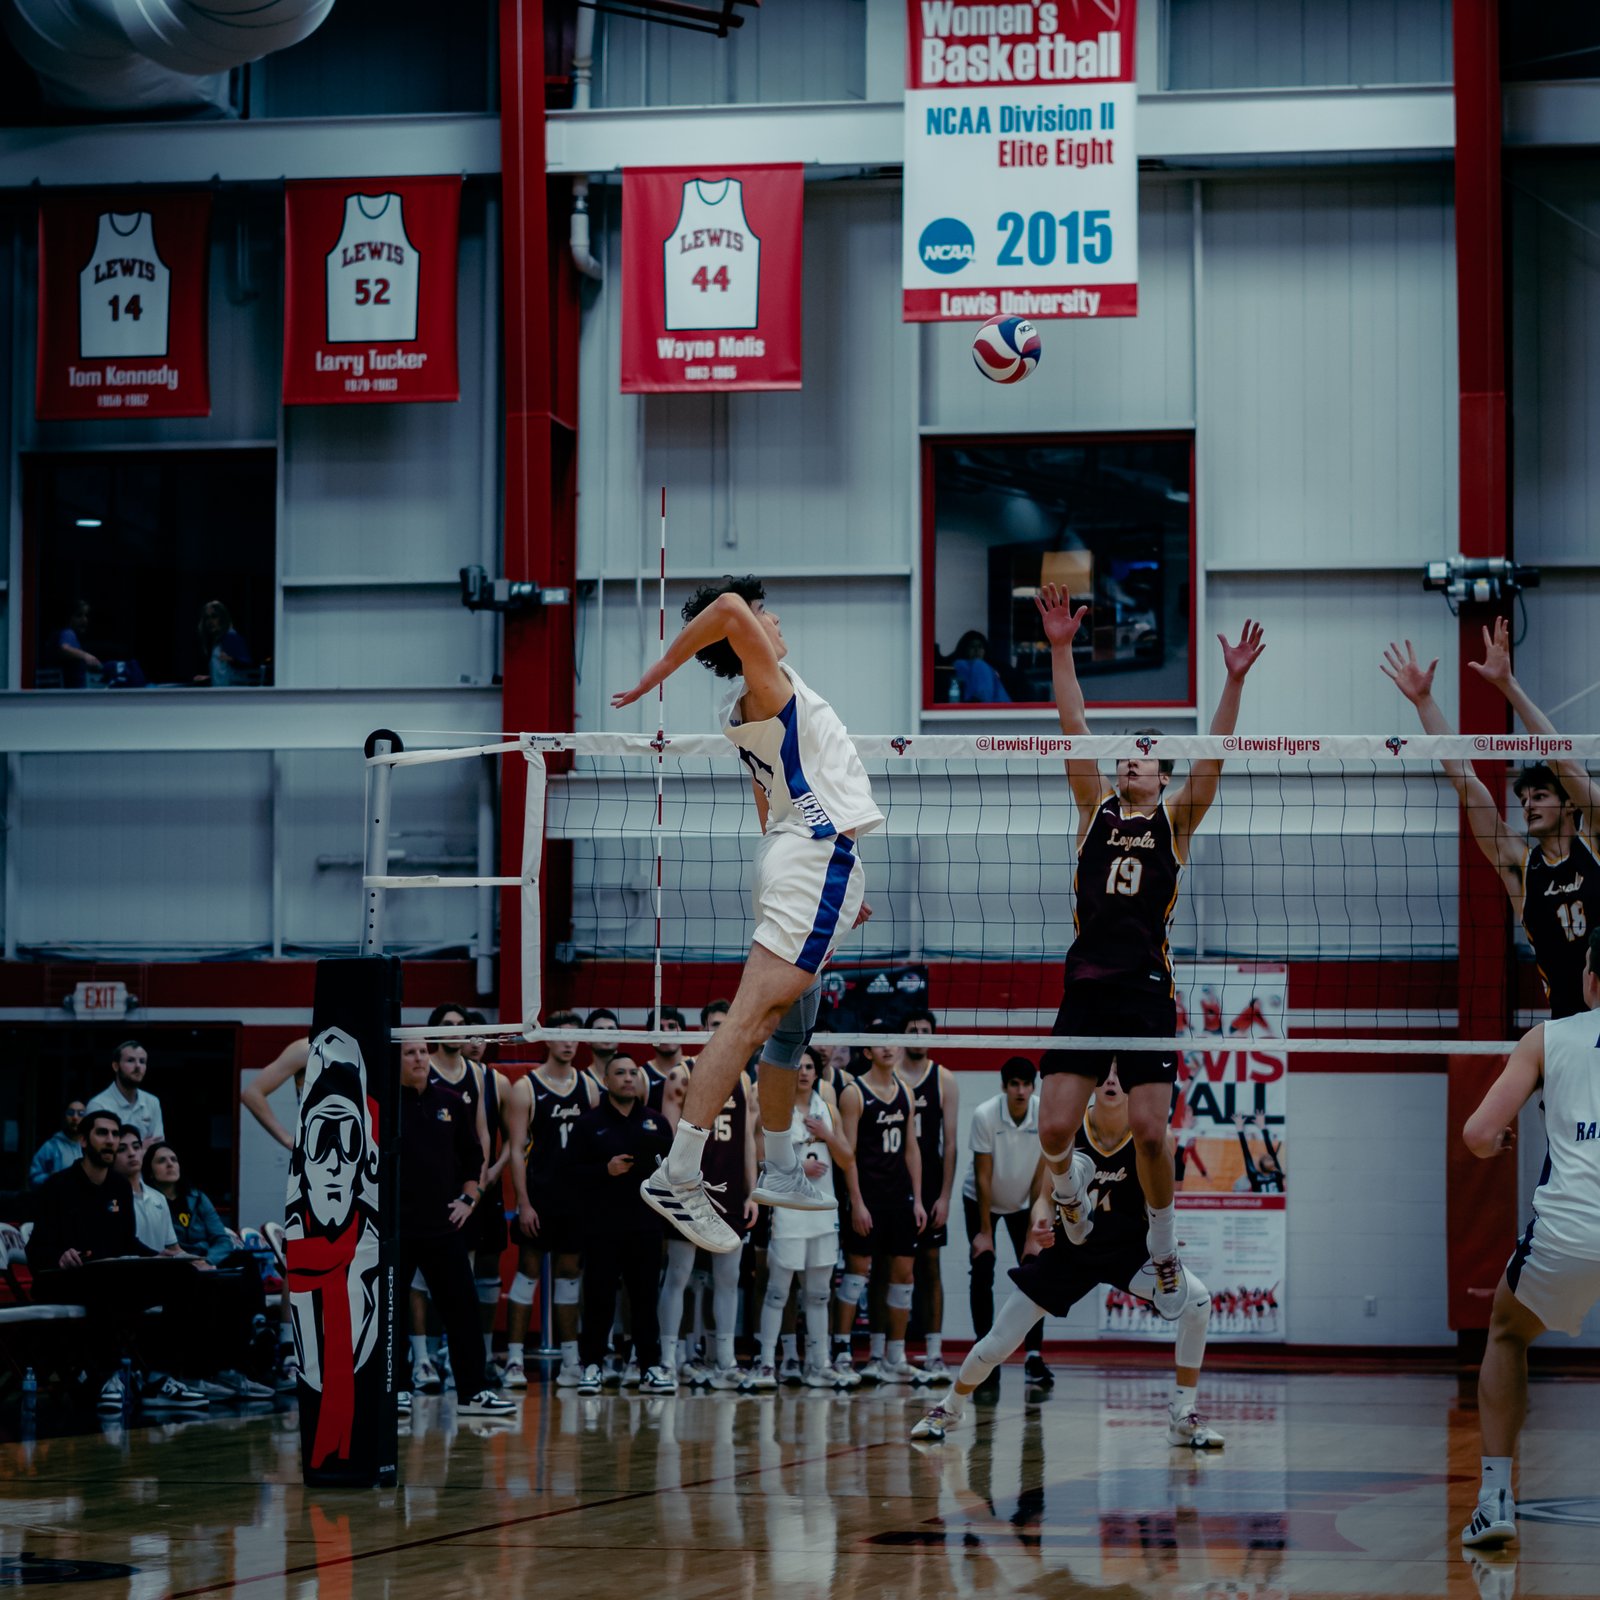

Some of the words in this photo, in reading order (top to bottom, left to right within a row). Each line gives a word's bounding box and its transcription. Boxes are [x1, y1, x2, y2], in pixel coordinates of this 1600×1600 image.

[921, 0, 1059, 37] Women's
[921, 32, 1121, 84] Basketball
[926, 106, 992, 136] NCAA
[1000, 104, 1092, 133] Division
[1100, 102, 1115, 131] II
[998, 140, 1048, 168] Elite
[1055, 138, 1114, 169] Eight
[680, 228, 744, 255] LEWIS
[996, 210, 1113, 267] 2015
[342, 241, 405, 268] LEWIS
[924, 244, 975, 262] NCAA
[94, 257, 156, 285] LEWIS
[692, 265, 731, 293] 44
[354, 278, 391, 306] 52
[940, 291, 997, 317] Lewis
[1000, 288, 1101, 316] University
[108, 294, 142, 322] 14
[315, 350, 364, 377] Larry
[368, 347, 428, 371] Tucker
[656, 336, 716, 362] Wayne
[718, 335, 766, 358] Molis
[69, 366, 102, 388] Tom
[105, 364, 179, 391] Kennedy
[975, 735, 1072, 756] @LewisFlyers
[1222, 735, 1321, 756] @LewisFlyers
[1473, 735, 1573, 756] @LewisFlyers
[1106, 827, 1156, 852] Loyola
[1105, 855, 1144, 897] 19
[1556, 900, 1587, 942] 18
[84, 986, 117, 1010] EXIT
[713, 1113, 733, 1142] 15
[881, 1126, 902, 1154] 10
[1575, 1121, 1600, 1142] RA
[387, 1265, 395, 1322] sports
[386, 1324, 394, 1393] imports
